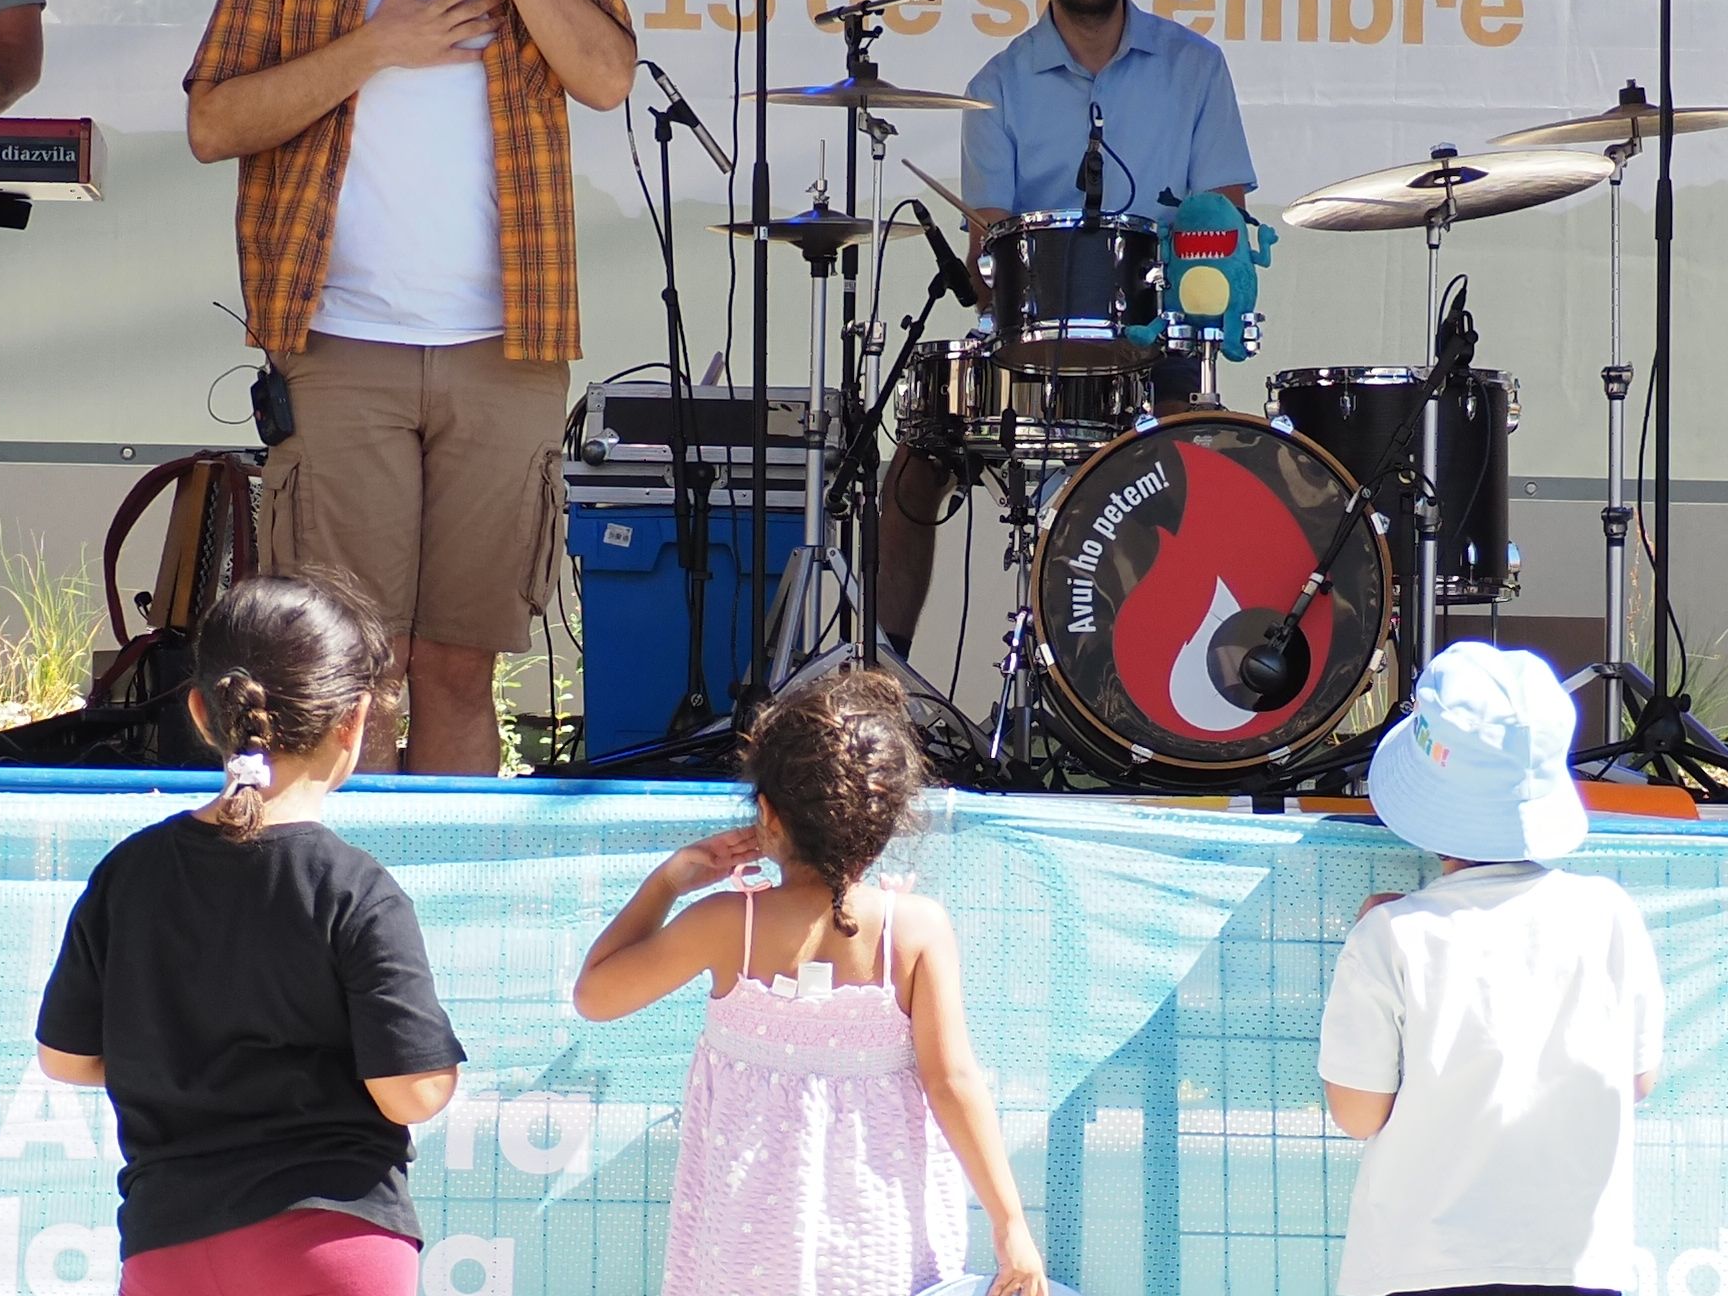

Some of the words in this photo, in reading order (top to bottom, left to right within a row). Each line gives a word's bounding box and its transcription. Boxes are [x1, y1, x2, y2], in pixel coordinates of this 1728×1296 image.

[1092, 461, 1170, 541] petem!
[1068, 539, 1103, 572] ho
[1067, 577, 1096, 633] Avui
